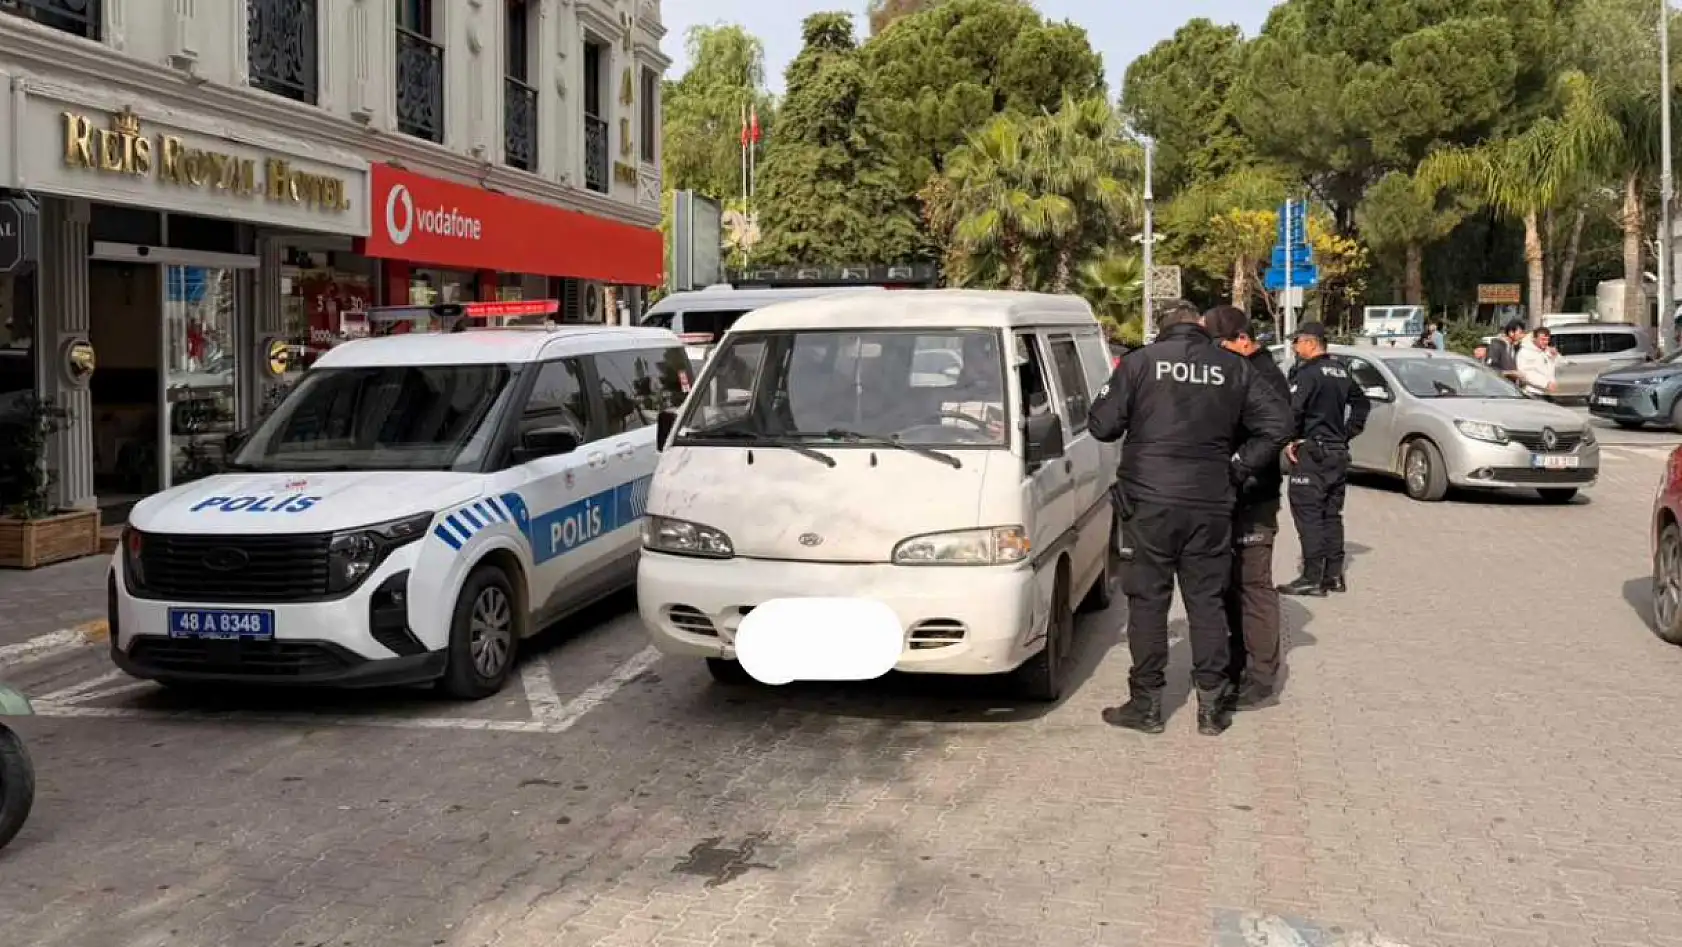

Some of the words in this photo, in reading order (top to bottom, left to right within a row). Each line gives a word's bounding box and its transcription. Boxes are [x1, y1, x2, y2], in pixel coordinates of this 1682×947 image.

[157, 133, 263, 197] ROYAL
[266, 156, 350, 211] HOTEL
[416, 204, 482, 240] vodafone
[179, 612, 199, 631] 48
[203, 613, 217, 631] A
[220, 613, 261, 632] 8348
